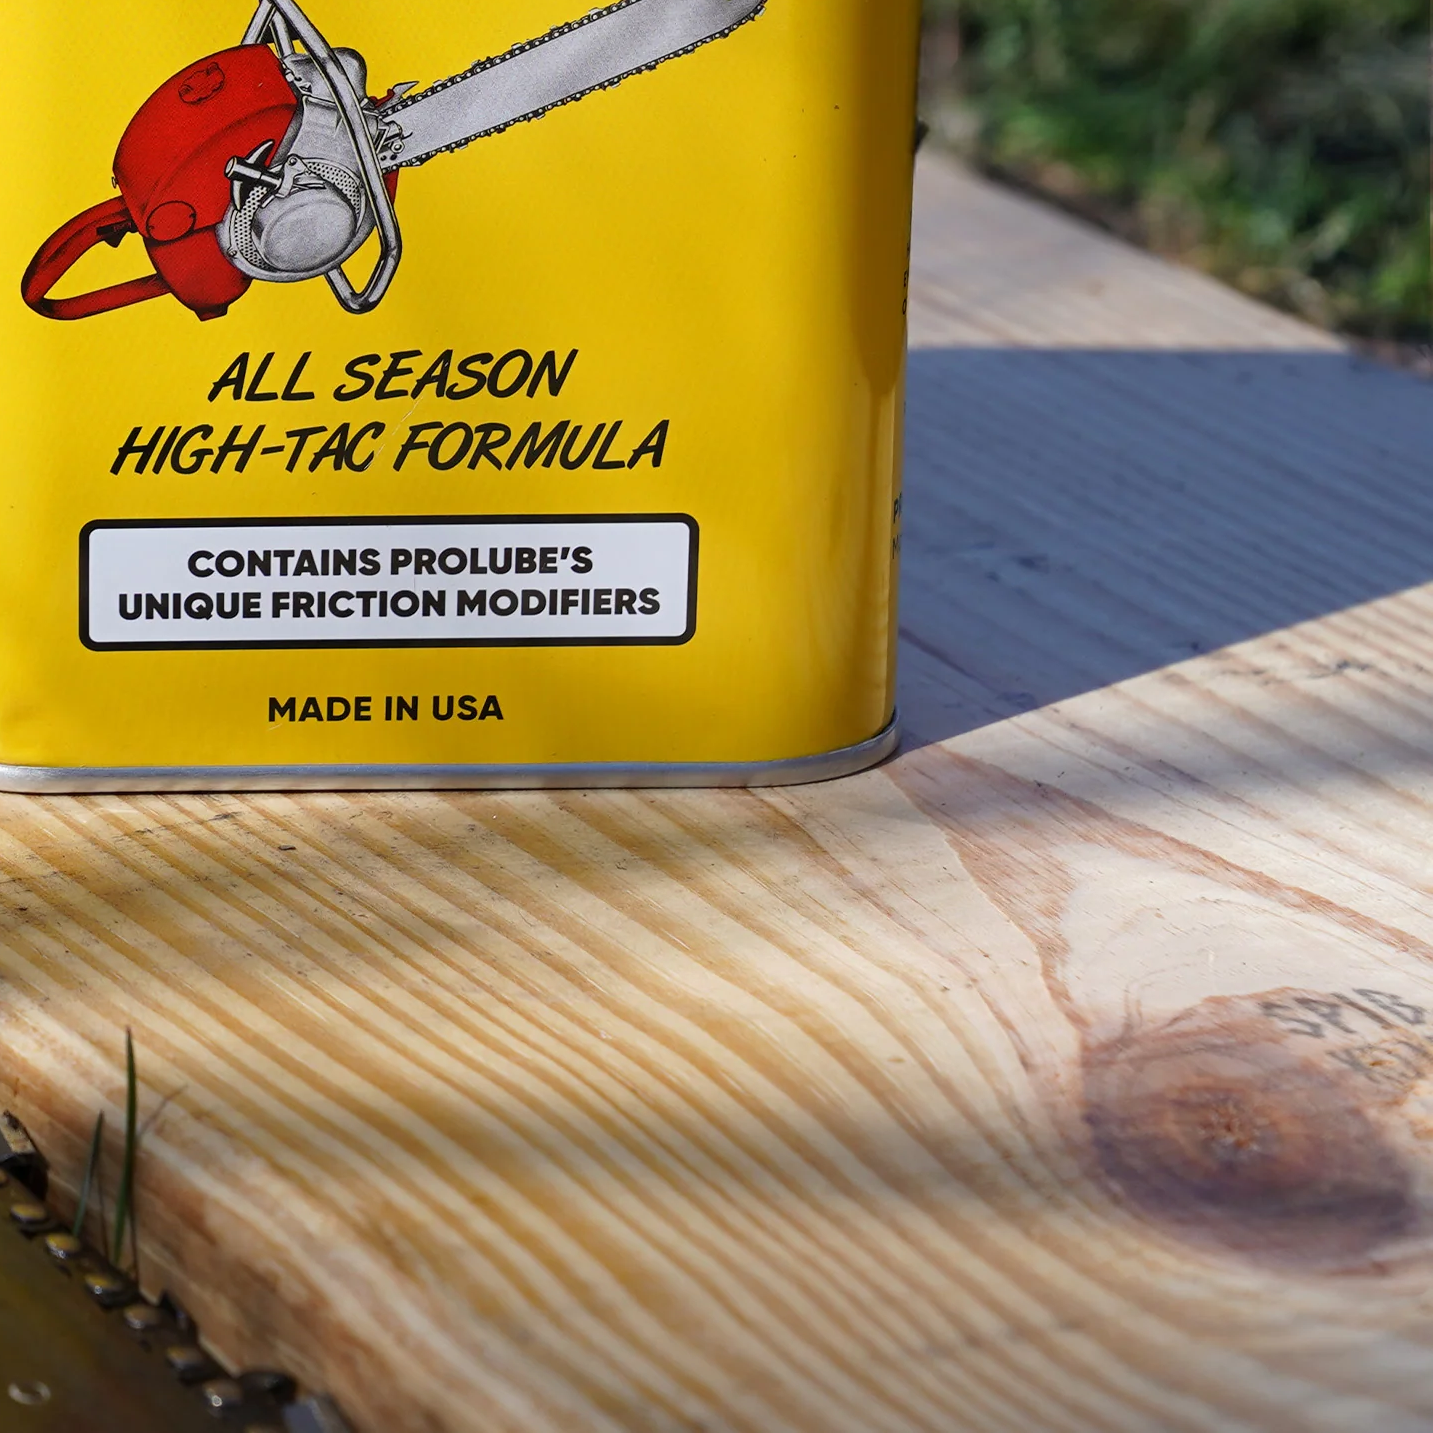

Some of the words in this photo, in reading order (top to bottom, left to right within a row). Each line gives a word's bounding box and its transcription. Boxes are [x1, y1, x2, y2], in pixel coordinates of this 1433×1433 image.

[208, 352, 314, 402] ALL
[334, 349, 578, 401] SEASON
[110, 422, 385, 475] HIGH-TAC
[393, 420, 669, 471] FORMULA
[188, 549, 380, 577] CONTAINS
[120, 593, 261, 620] UNIQUE
[273, 590, 445, 618] FRICTION
[457, 588, 660, 616] MODIFIERS
[269, 697, 371, 721] MADE
[386, 696, 418, 720] IN
[433, 695, 503, 720] USA
